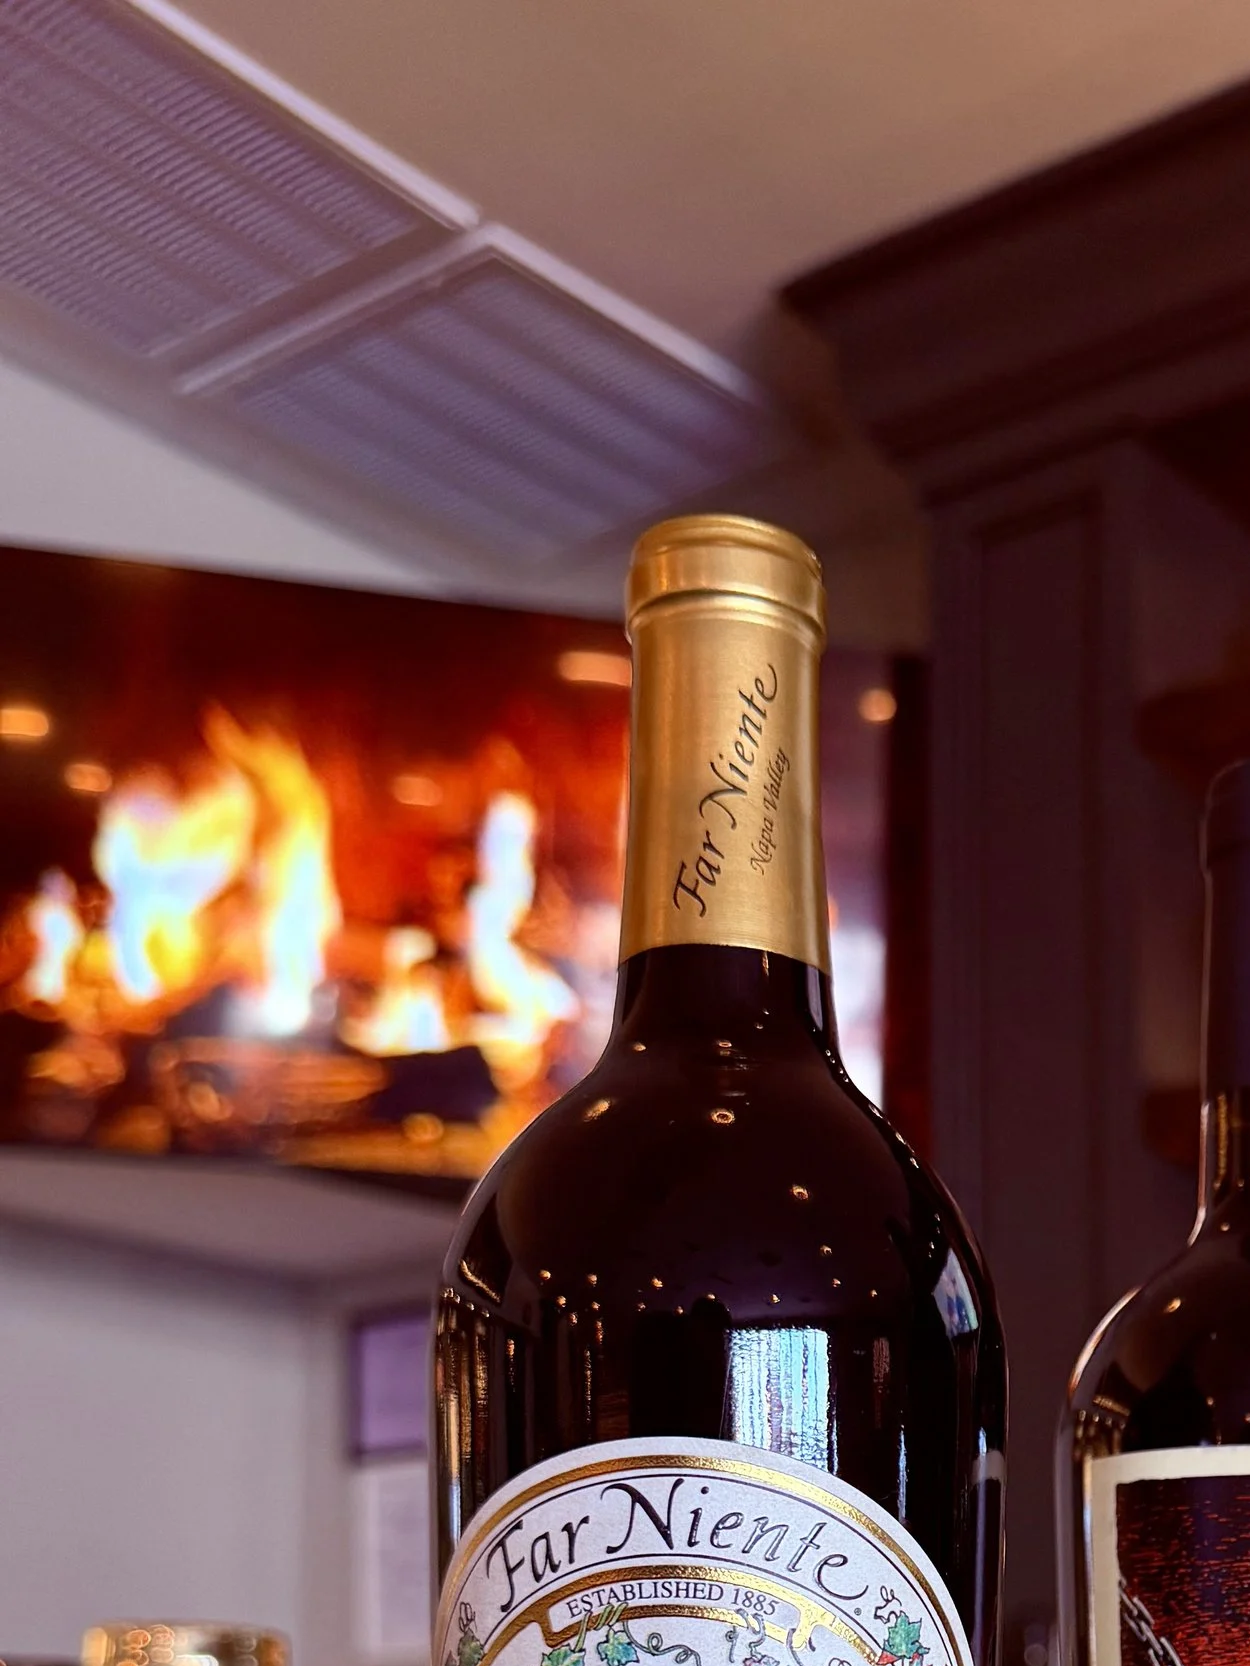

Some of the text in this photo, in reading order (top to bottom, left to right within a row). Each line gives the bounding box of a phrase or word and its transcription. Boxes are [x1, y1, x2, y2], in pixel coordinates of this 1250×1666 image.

[673, 663, 778, 918] Far Niente
[750, 748, 791, 876] Napa Valley
[486, 1477, 869, 1613] Far Niente
[566, 1582, 781, 1619] ESTABLISHED 1885
